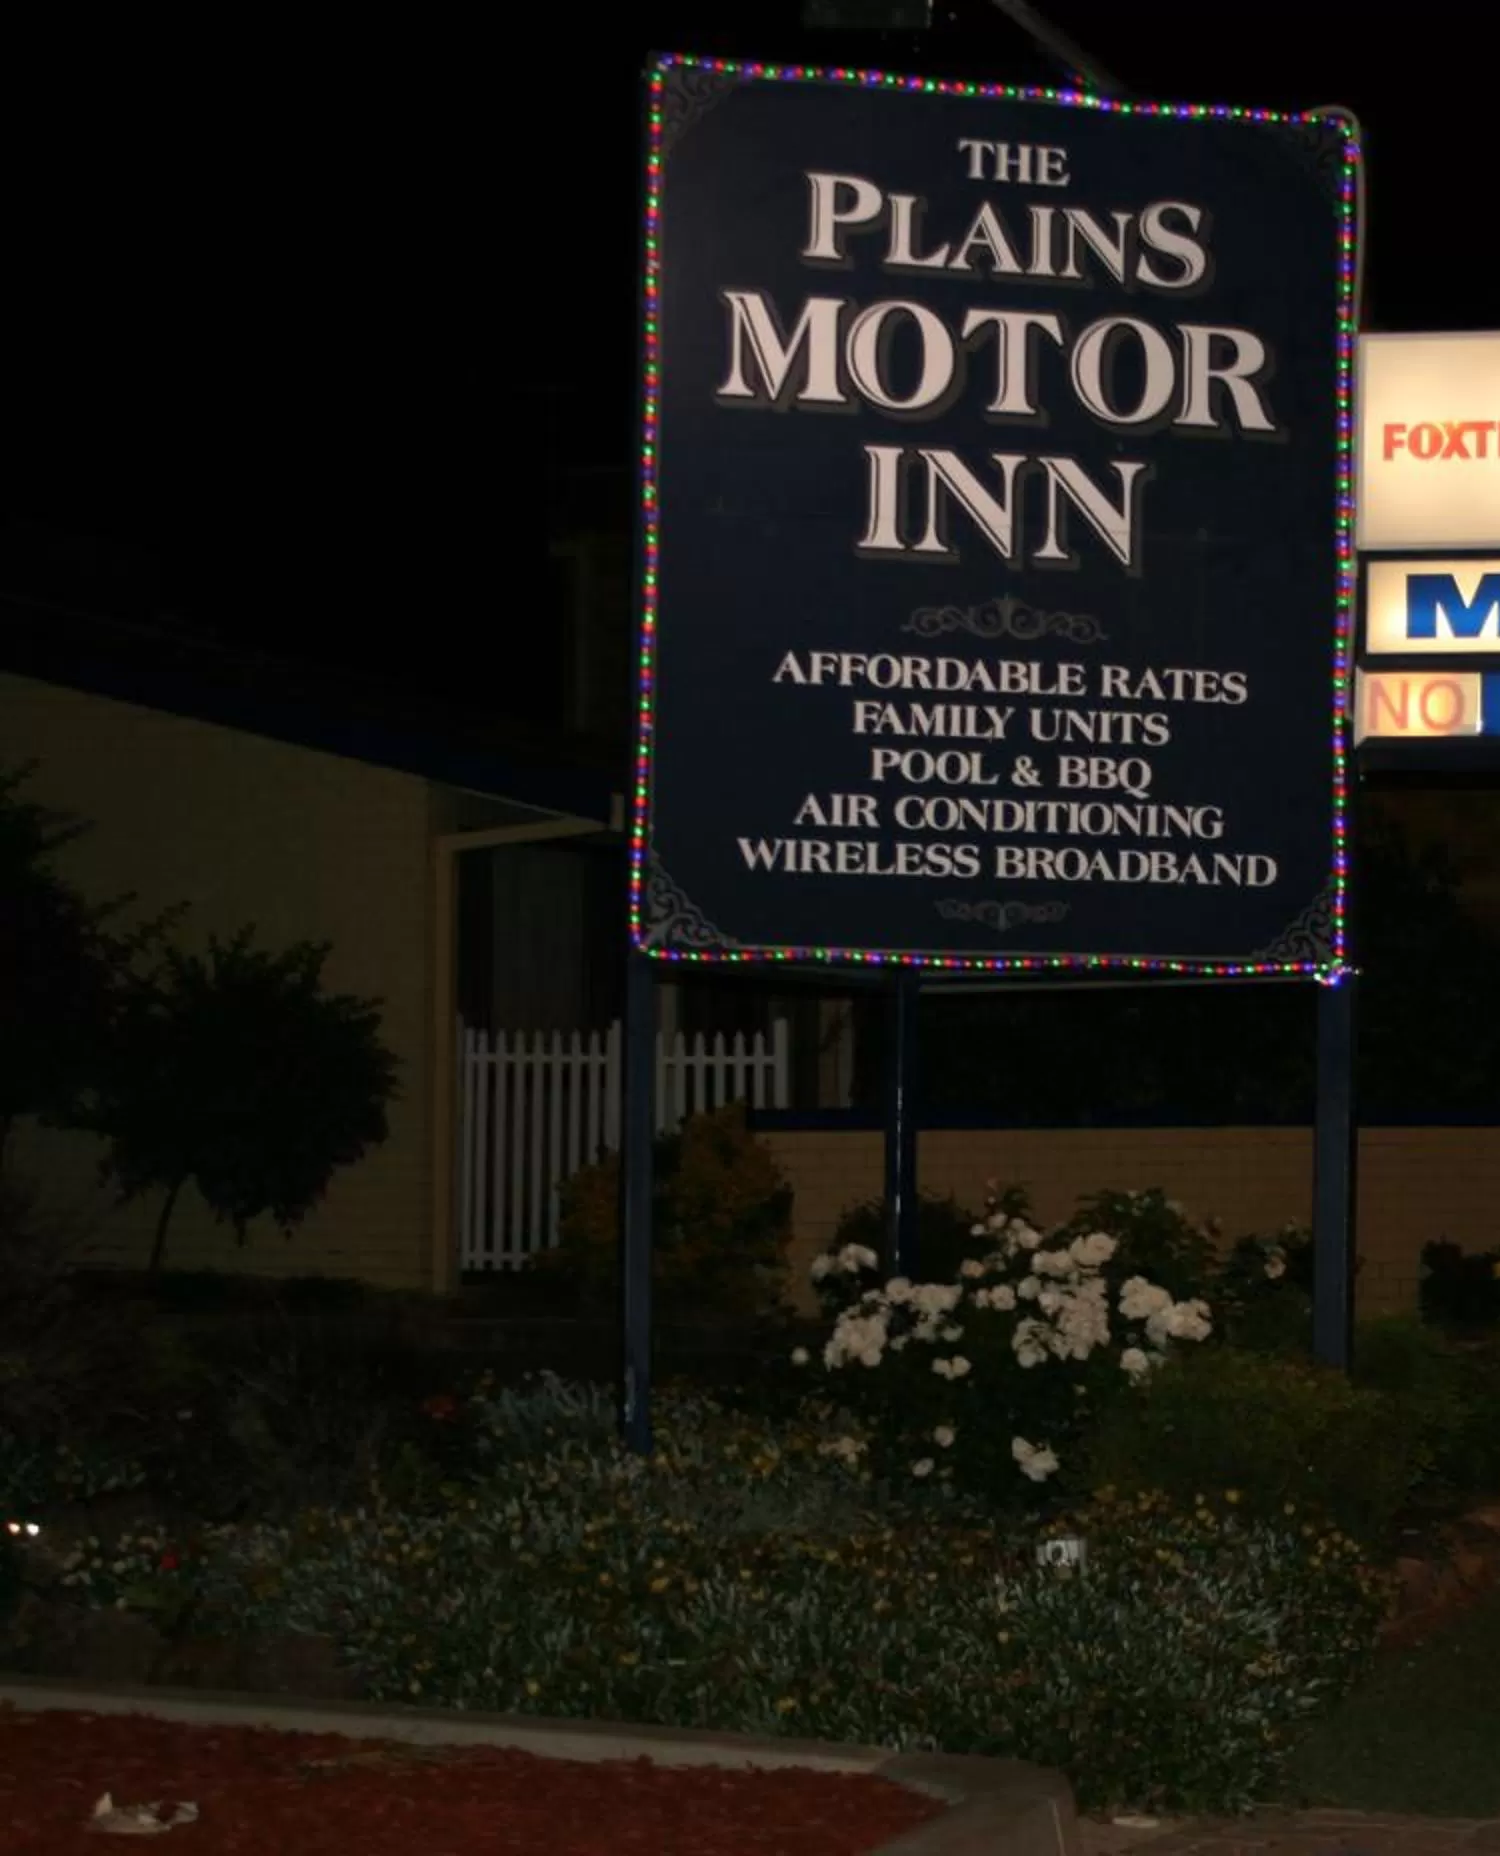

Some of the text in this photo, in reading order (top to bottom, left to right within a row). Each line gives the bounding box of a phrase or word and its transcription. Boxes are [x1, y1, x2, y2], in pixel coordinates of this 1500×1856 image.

[958, 139, 1070, 187] THE
[802, 172, 1208, 290] PLAINS
[717, 291, 1277, 434] MOTOR
[858, 444, 1145, 567] INN
[773, 650, 1248, 705] AFFORDABLE RATES
[852, 700, 1171, 746] FAMILY UNITS
[1366, 679, 1466, 733] NO
[871, 748, 1152, 796] POOL & BBQ
[793, 793, 1224, 839] AIR CONDITIONING
[737, 838, 1278, 887] WIRELESS BROADBAND
